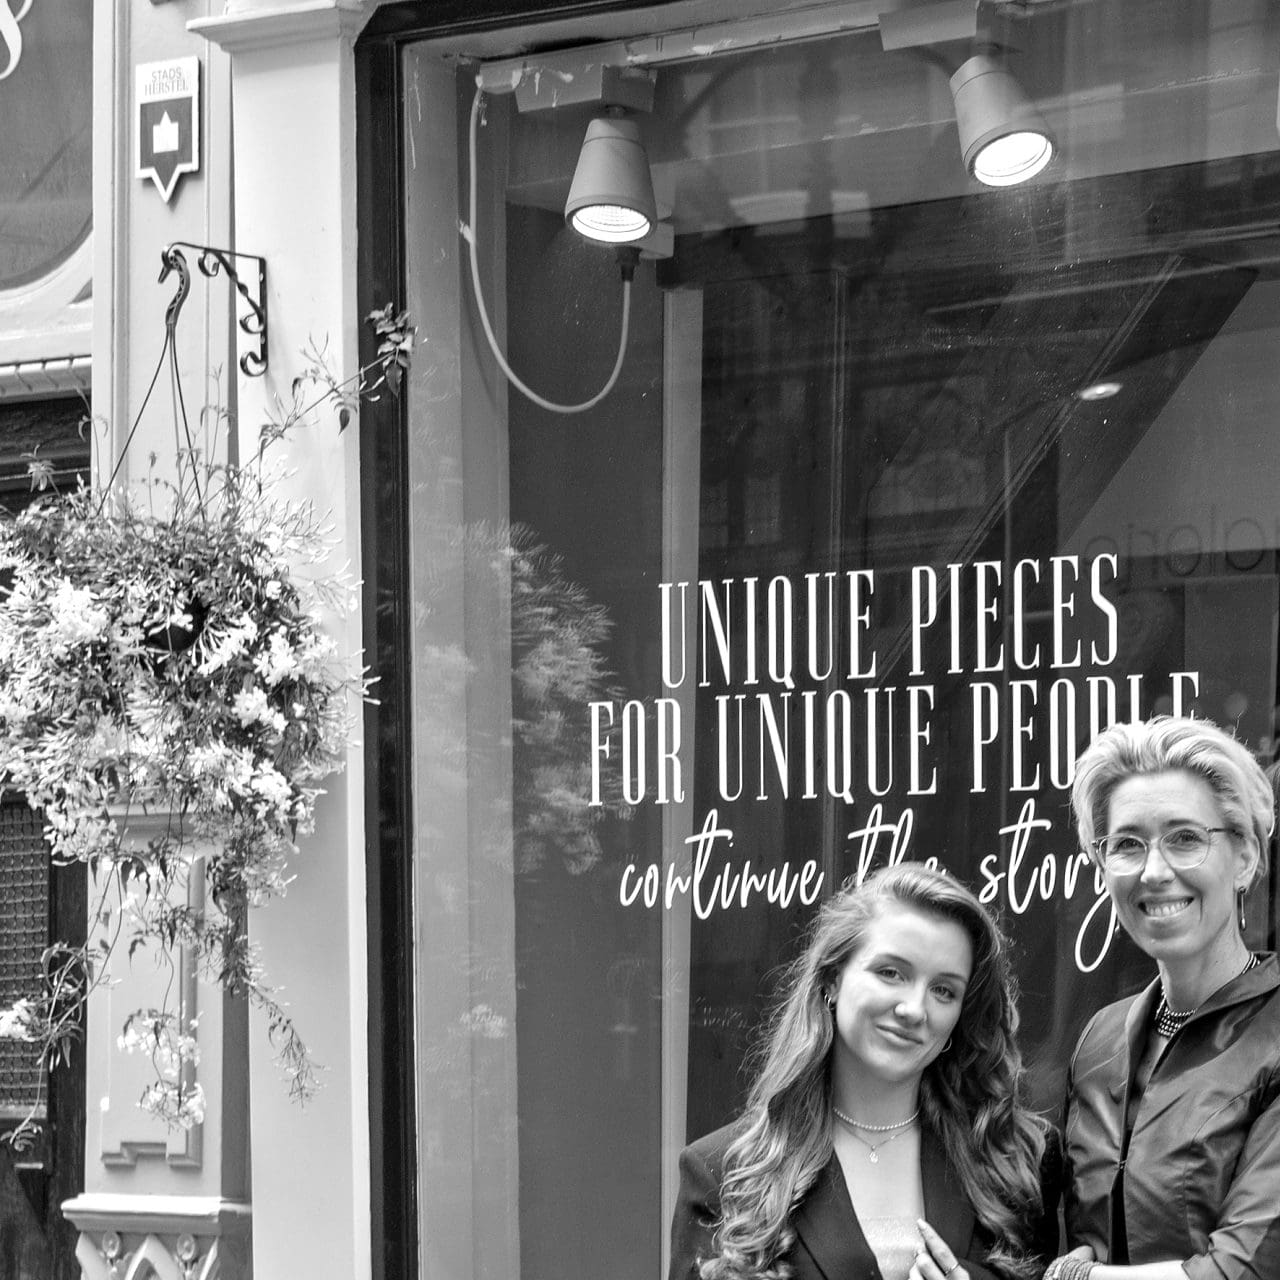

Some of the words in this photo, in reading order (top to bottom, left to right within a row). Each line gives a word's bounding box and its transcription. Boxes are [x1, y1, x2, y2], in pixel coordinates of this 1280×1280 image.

[144, 79, 189, 97] HERSTEL
[151, 67, 182, 82] STADS
[658, 569, 877, 689] UNIQUE
[908, 552, 1118, 677] PIECES
[587, 697, 685, 807] FOR
[715, 684, 938, 805] UNIQUE
[619, 808, 825, 920] continue
[979, 798, 1112, 973] story
